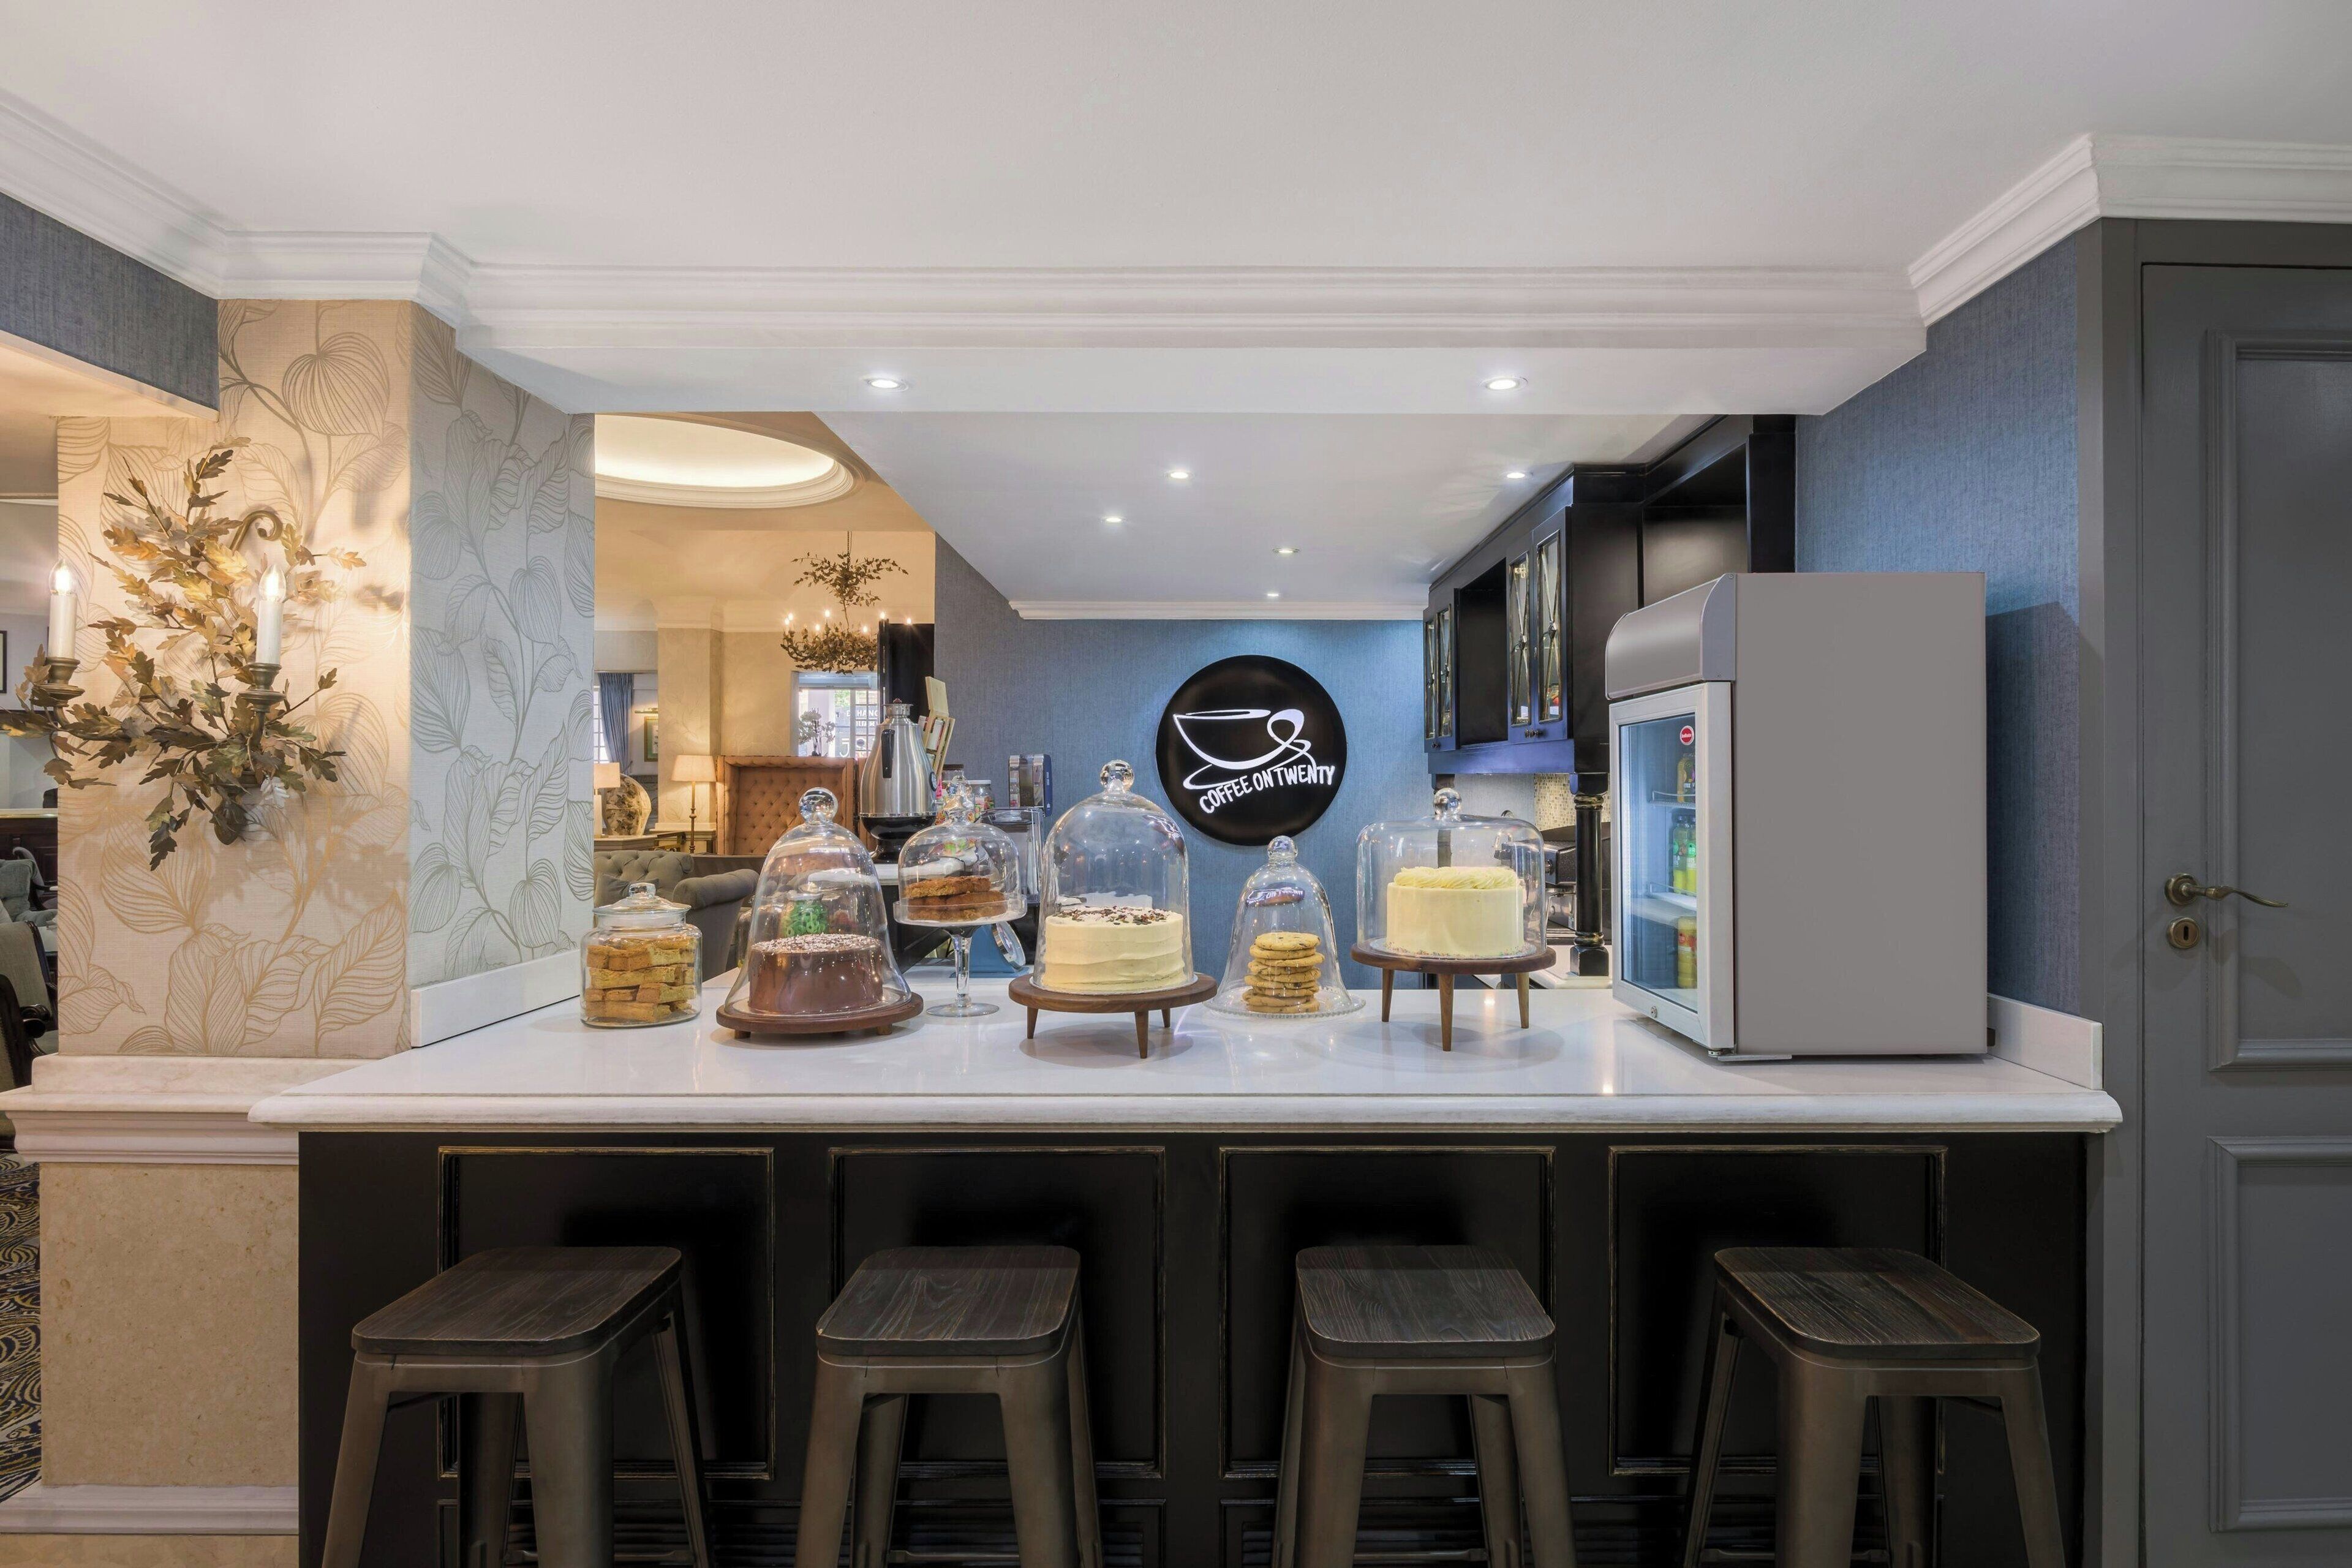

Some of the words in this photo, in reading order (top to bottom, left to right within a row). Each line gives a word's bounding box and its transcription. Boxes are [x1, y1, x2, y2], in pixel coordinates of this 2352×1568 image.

[1199, 775, 1253, 813] COFFEE
[1253, 767, 1274, 791] ON
[1273, 765, 1335, 786] TWENTY
